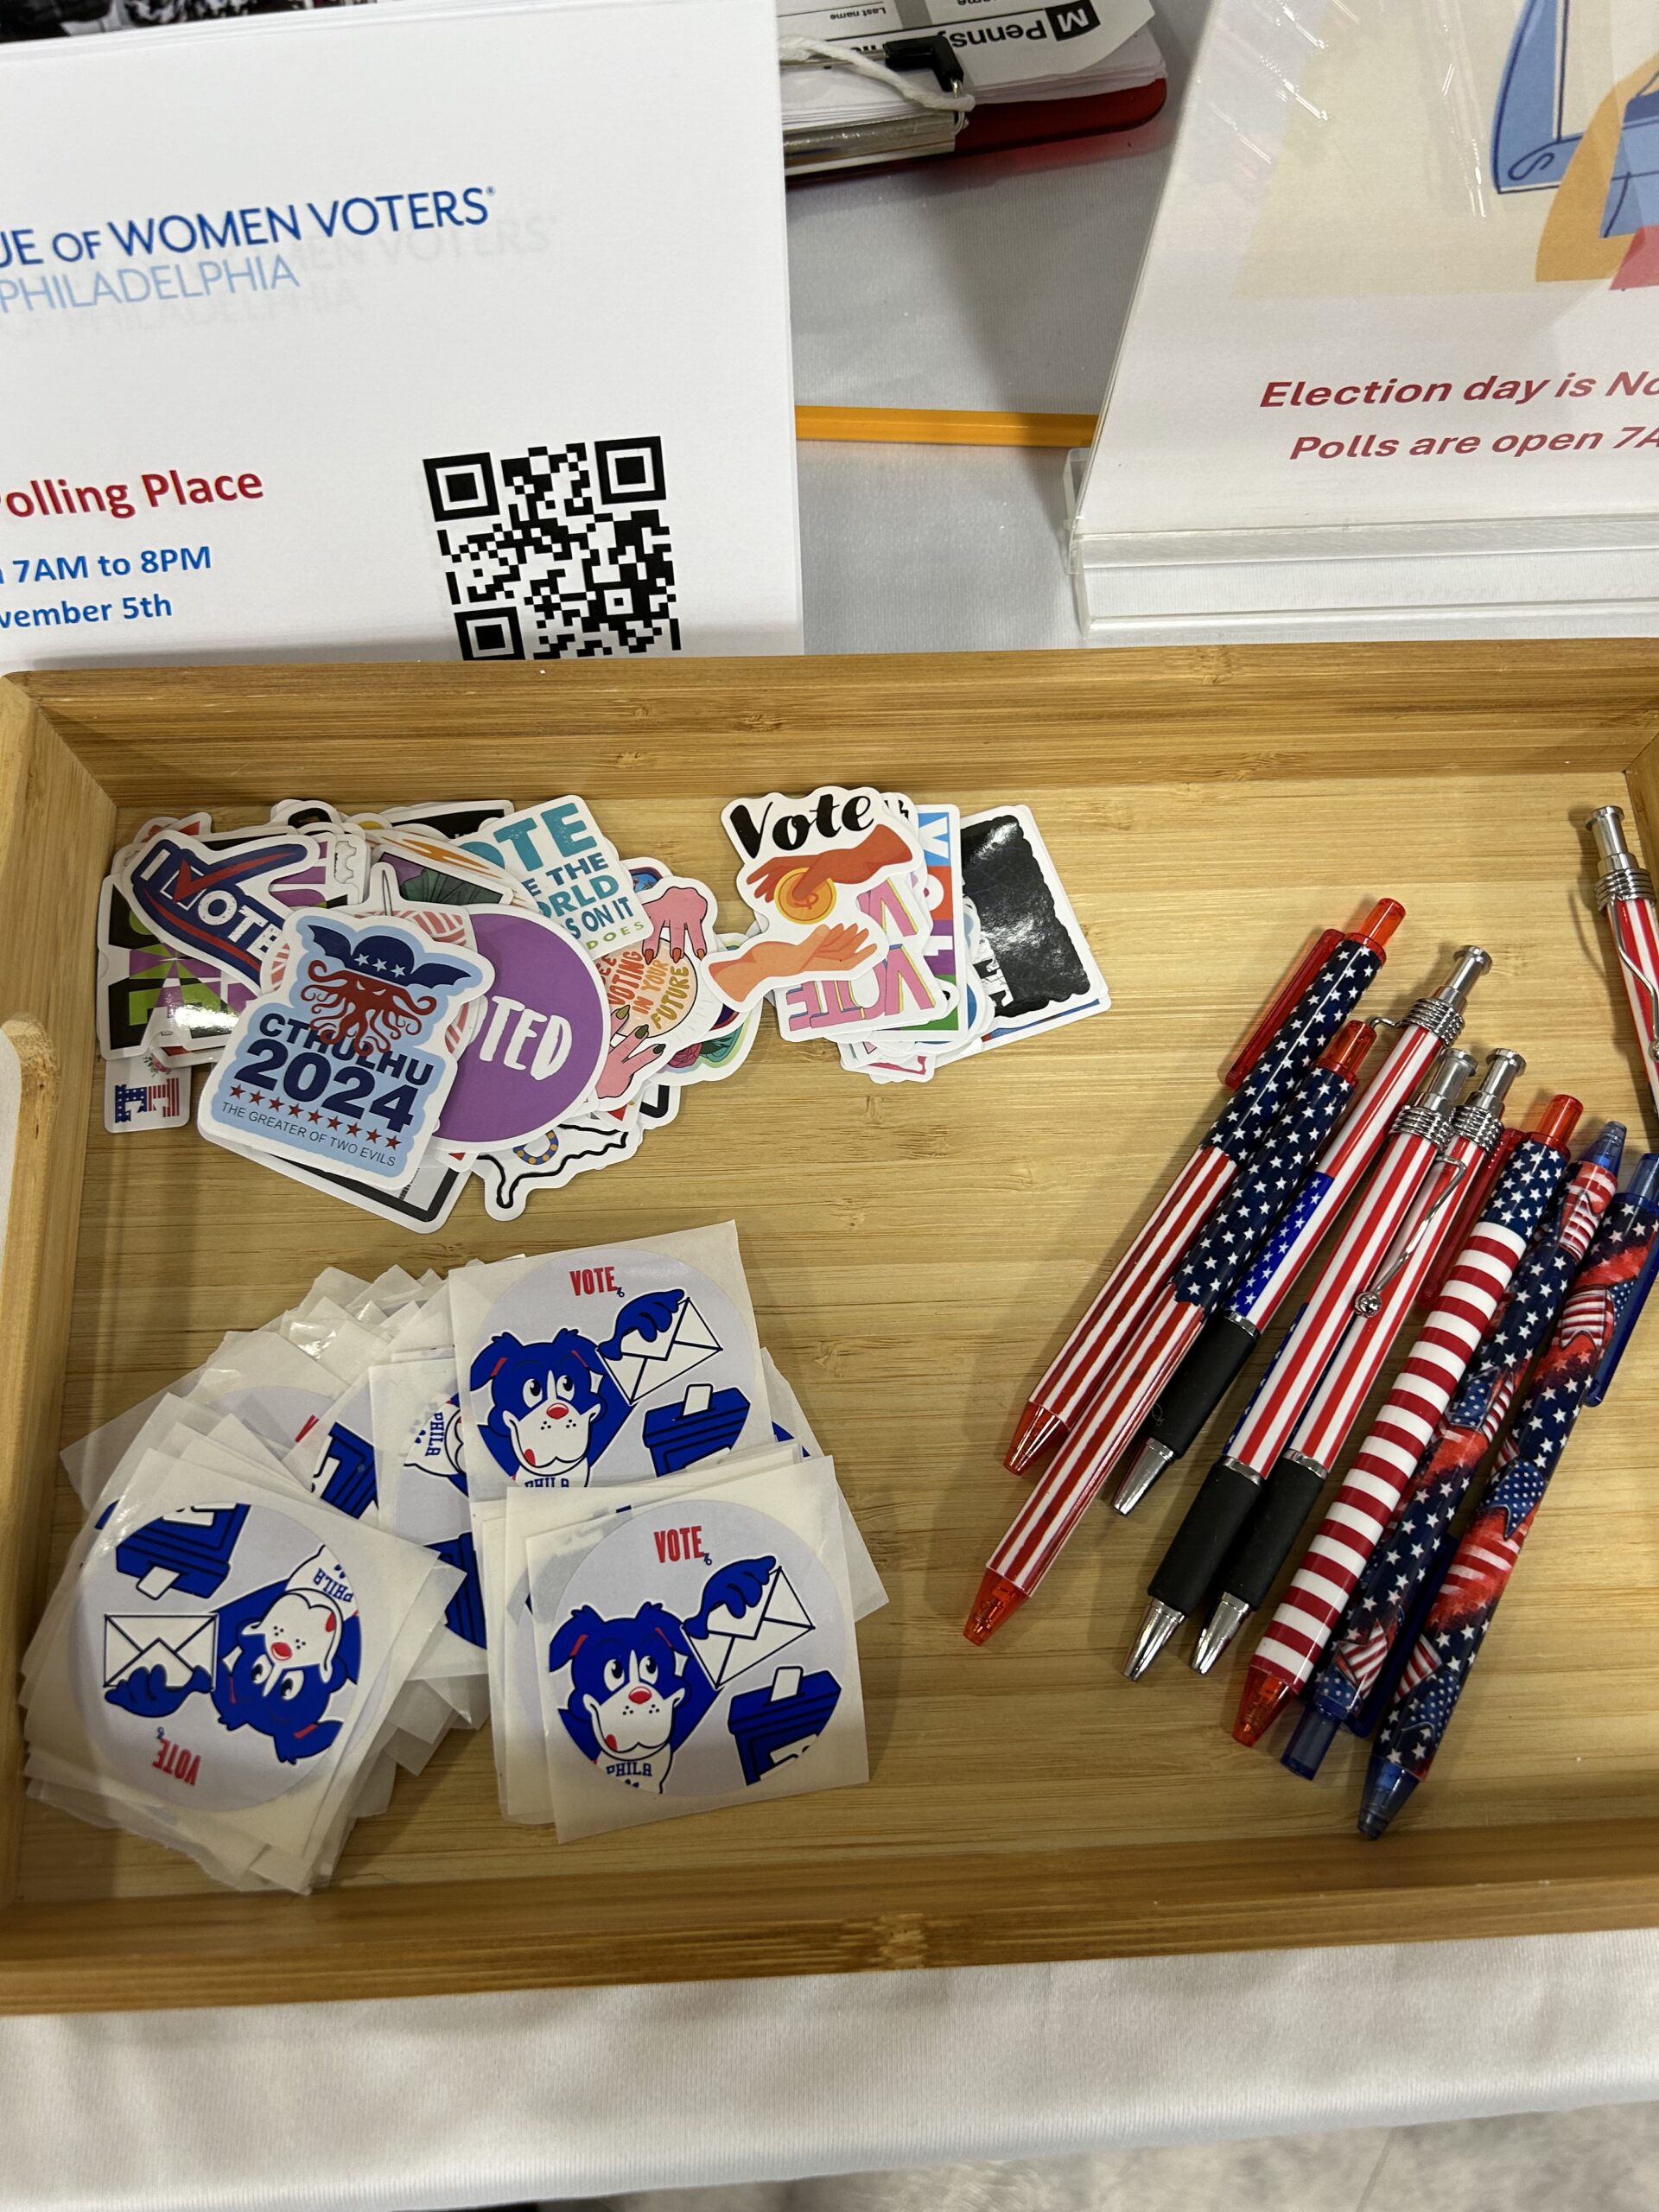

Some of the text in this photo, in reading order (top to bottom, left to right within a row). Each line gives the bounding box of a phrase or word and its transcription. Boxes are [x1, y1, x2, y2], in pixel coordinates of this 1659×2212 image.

[830, 7, 887, 20] Last name
[52, 230, 101, 263] OF
[107, 204, 301, 257] WOMEN
[0, 254, 301, 314] PHILADELPHIA
[1260, 378, 1452, 408] Election
[1463, 375, 1551, 405] day
[1554, 372, 1598, 398] is
[1289, 434, 1399, 461] Polls
[1408, 435, 1481, 456] are
[1491, 431, 1604, 458] open
[0, 469, 264, 519] olling Place
[13, 556, 89, 583] 7AM
[98, 556, 130, 577] to
[140, 545, 211, 574] 8PM
[123, 593, 173, 620] 5th
[730, 792, 874, 859] Vote
[545, 852, 608, 887] THE
[582, 904, 615, 932] ON
[613, 896, 634, 919] IT
[586, 921, 644, 950] DOES
[632, 959, 670, 1015] IN YOUR
[651, 965, 690, 1030] FUTURE
[260, 1013, 434, 1086] CTHULHU
[234, 1039, 419, 1134] 2024
[221, 1101, 396, 1166] THE GREATER OF TWO EVILS
[569, 1266, 617, 1297] VOTE
[425, 1412, 445, 1457] PHILA
[654, 1525, 704, 1563] VOTE
[313, 1567, 354, 1603] PHILA
[152, 1737, 202, 1787] VOTE
[606, 1761, 652, 1777] PHILA
